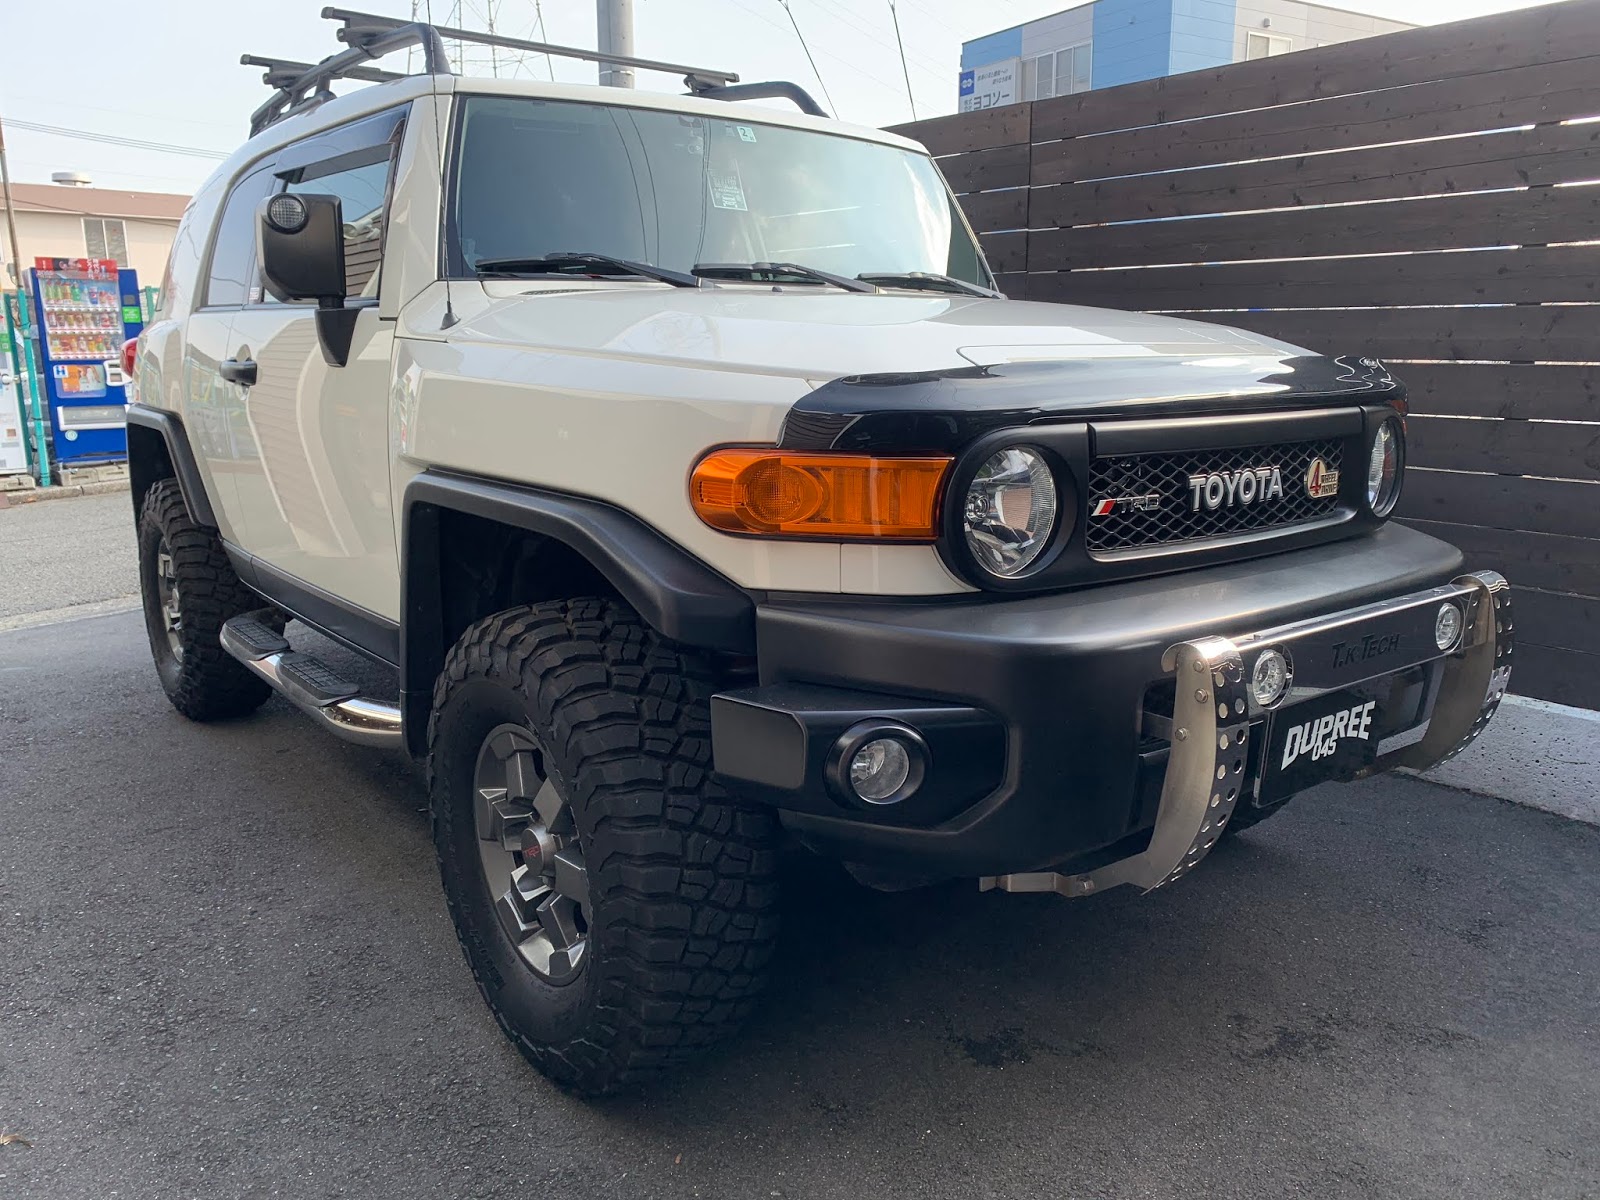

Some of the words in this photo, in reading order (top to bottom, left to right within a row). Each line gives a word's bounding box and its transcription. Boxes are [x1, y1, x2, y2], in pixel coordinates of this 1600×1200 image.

[974, 91, 1010, 110] ヨコソー
[1188, 466, 1284, 511] TOYOTA
[1309, 461, 1321, 496] 4
[1320, 473, 1337, 484] WHEEL
[1116, 493, 1161, 514] TRD
[1281, 700, 1376, 771] DUPREE
[1311, 738, 1337, 762] 045
